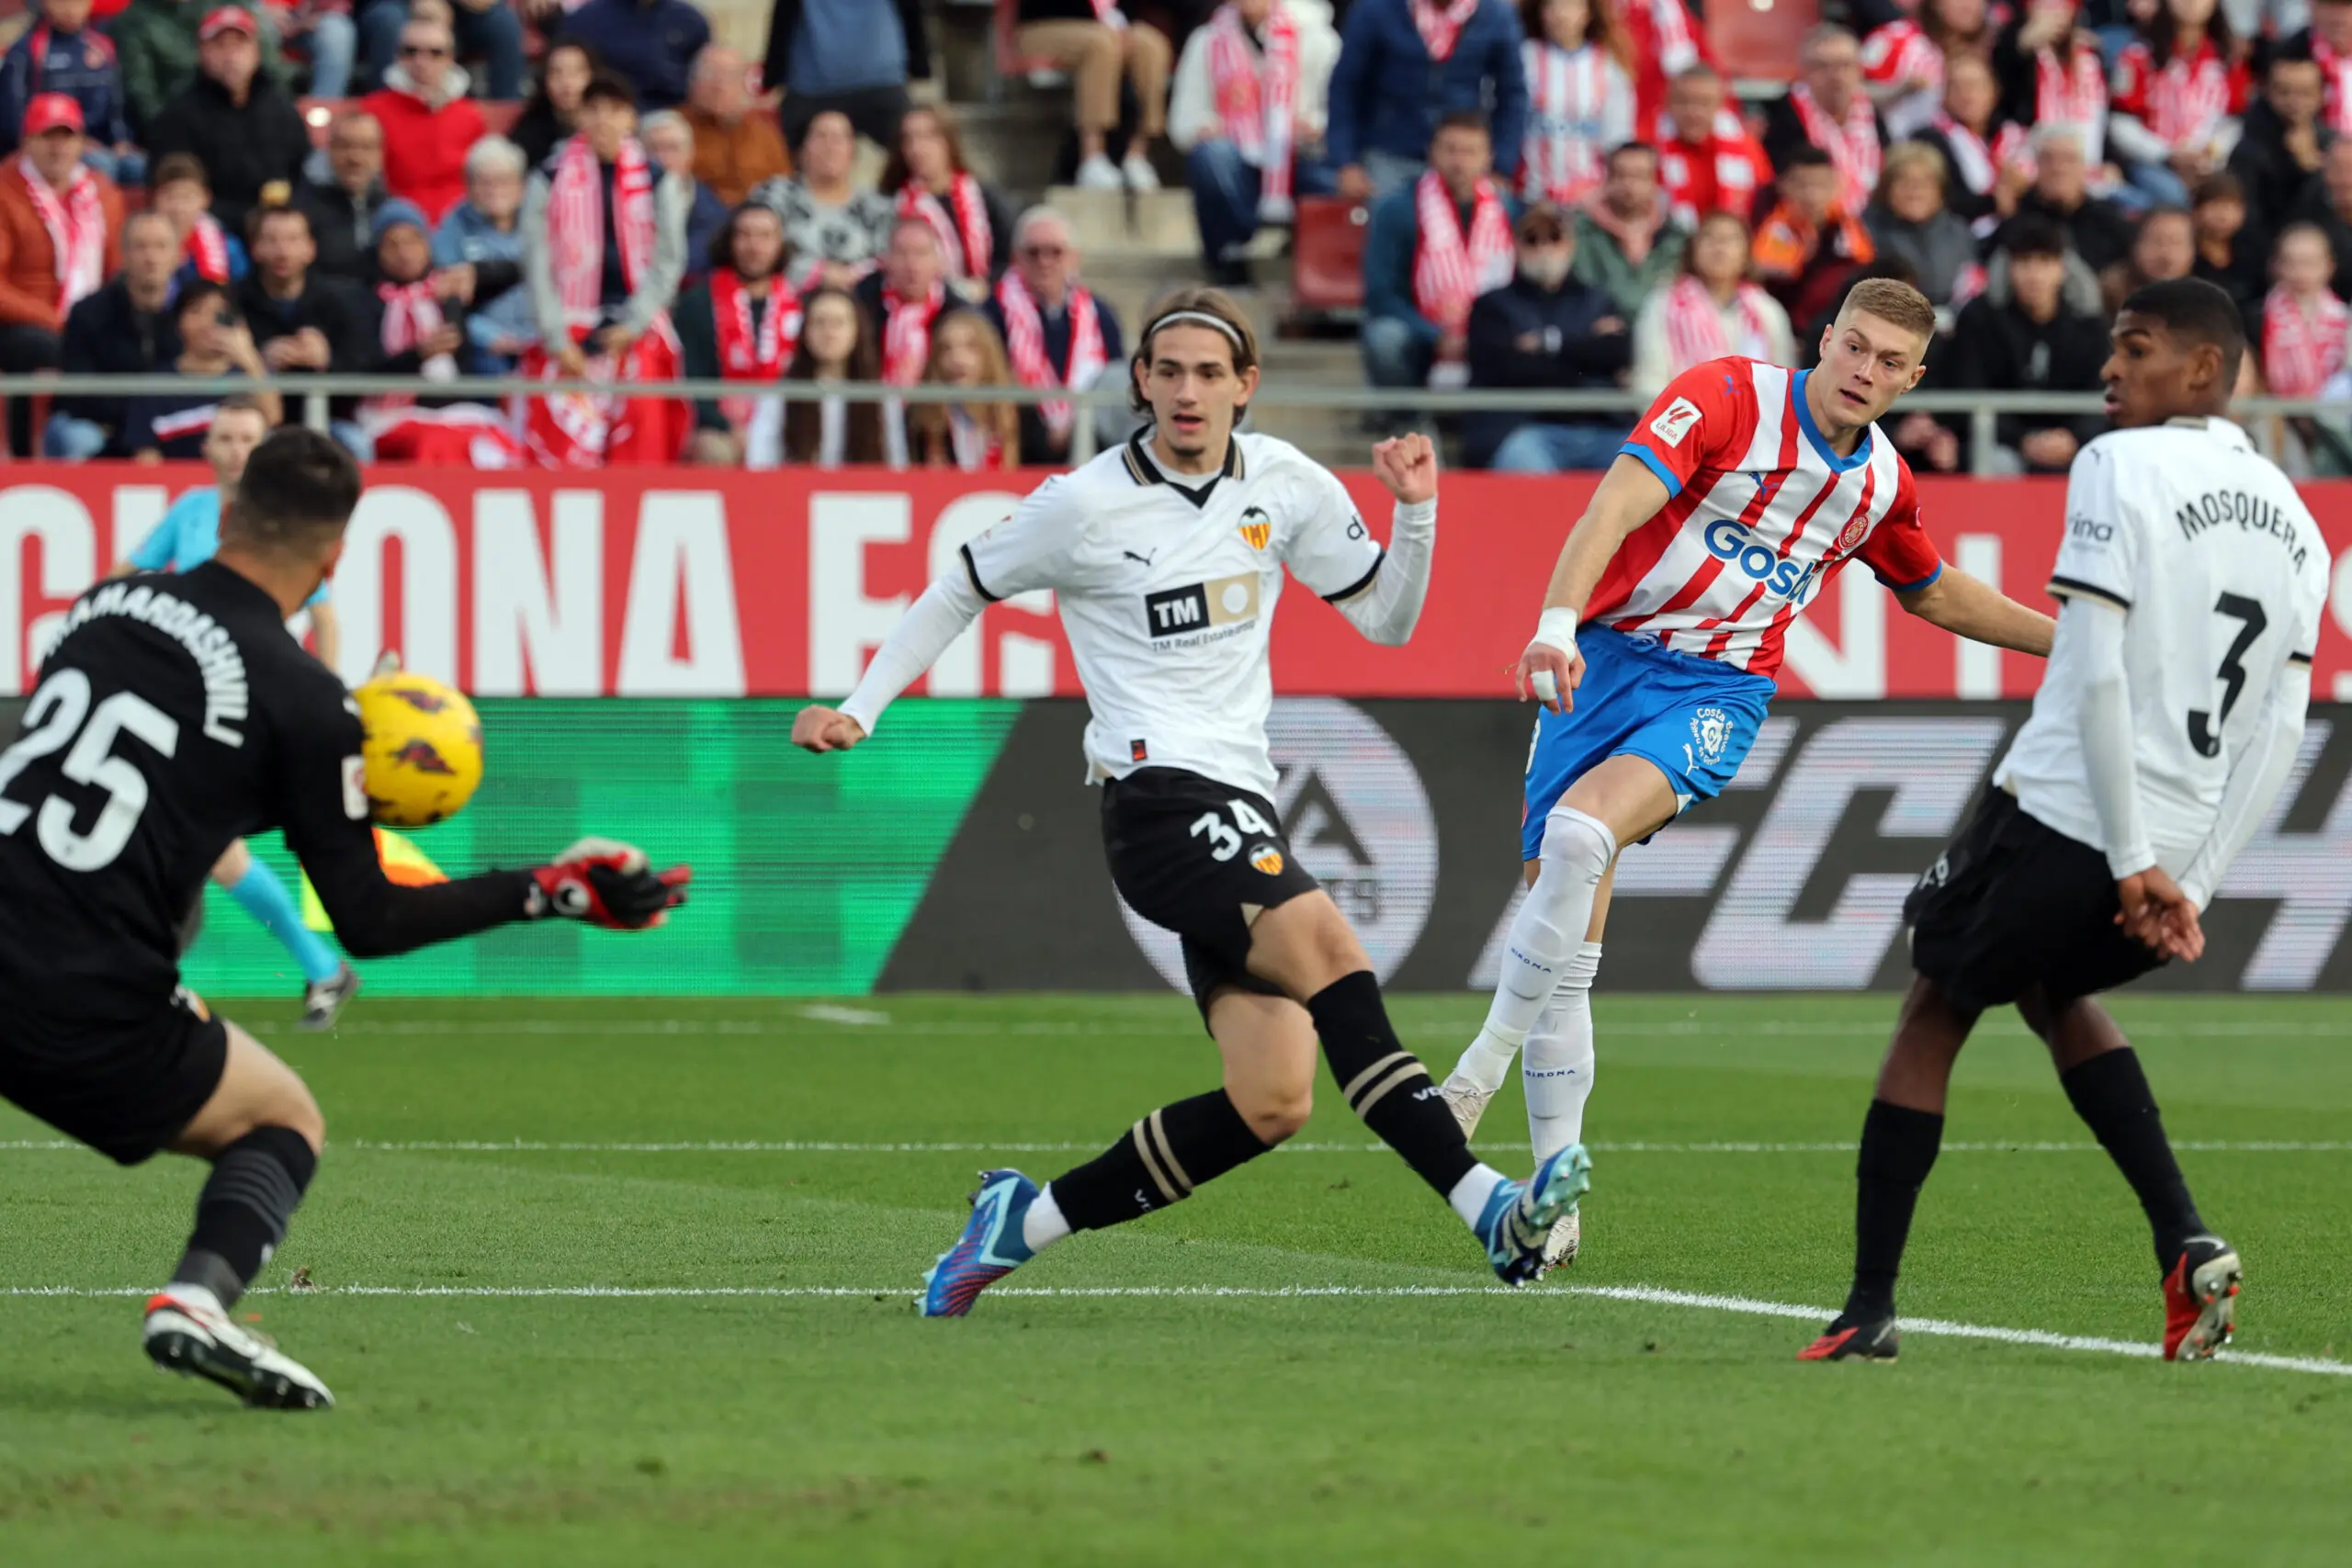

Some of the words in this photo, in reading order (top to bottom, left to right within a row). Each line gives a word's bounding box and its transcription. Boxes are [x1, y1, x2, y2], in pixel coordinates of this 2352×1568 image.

[1704, 519, 1815, 605] Gosbi
[2176, 489, 2307, 576] MOSQUERA
[1153, 595, 1200, 628] TM
[1152, 640, 1171, 652] TM
[2187, 590, 2268, 759] 3
[1696, 708, 1725, 722] Costa
[0, 667, 180, 873] 25
[1190, 797, 1277, 862] 34
[1525, 1068, 1576, 1078] GIRONA
